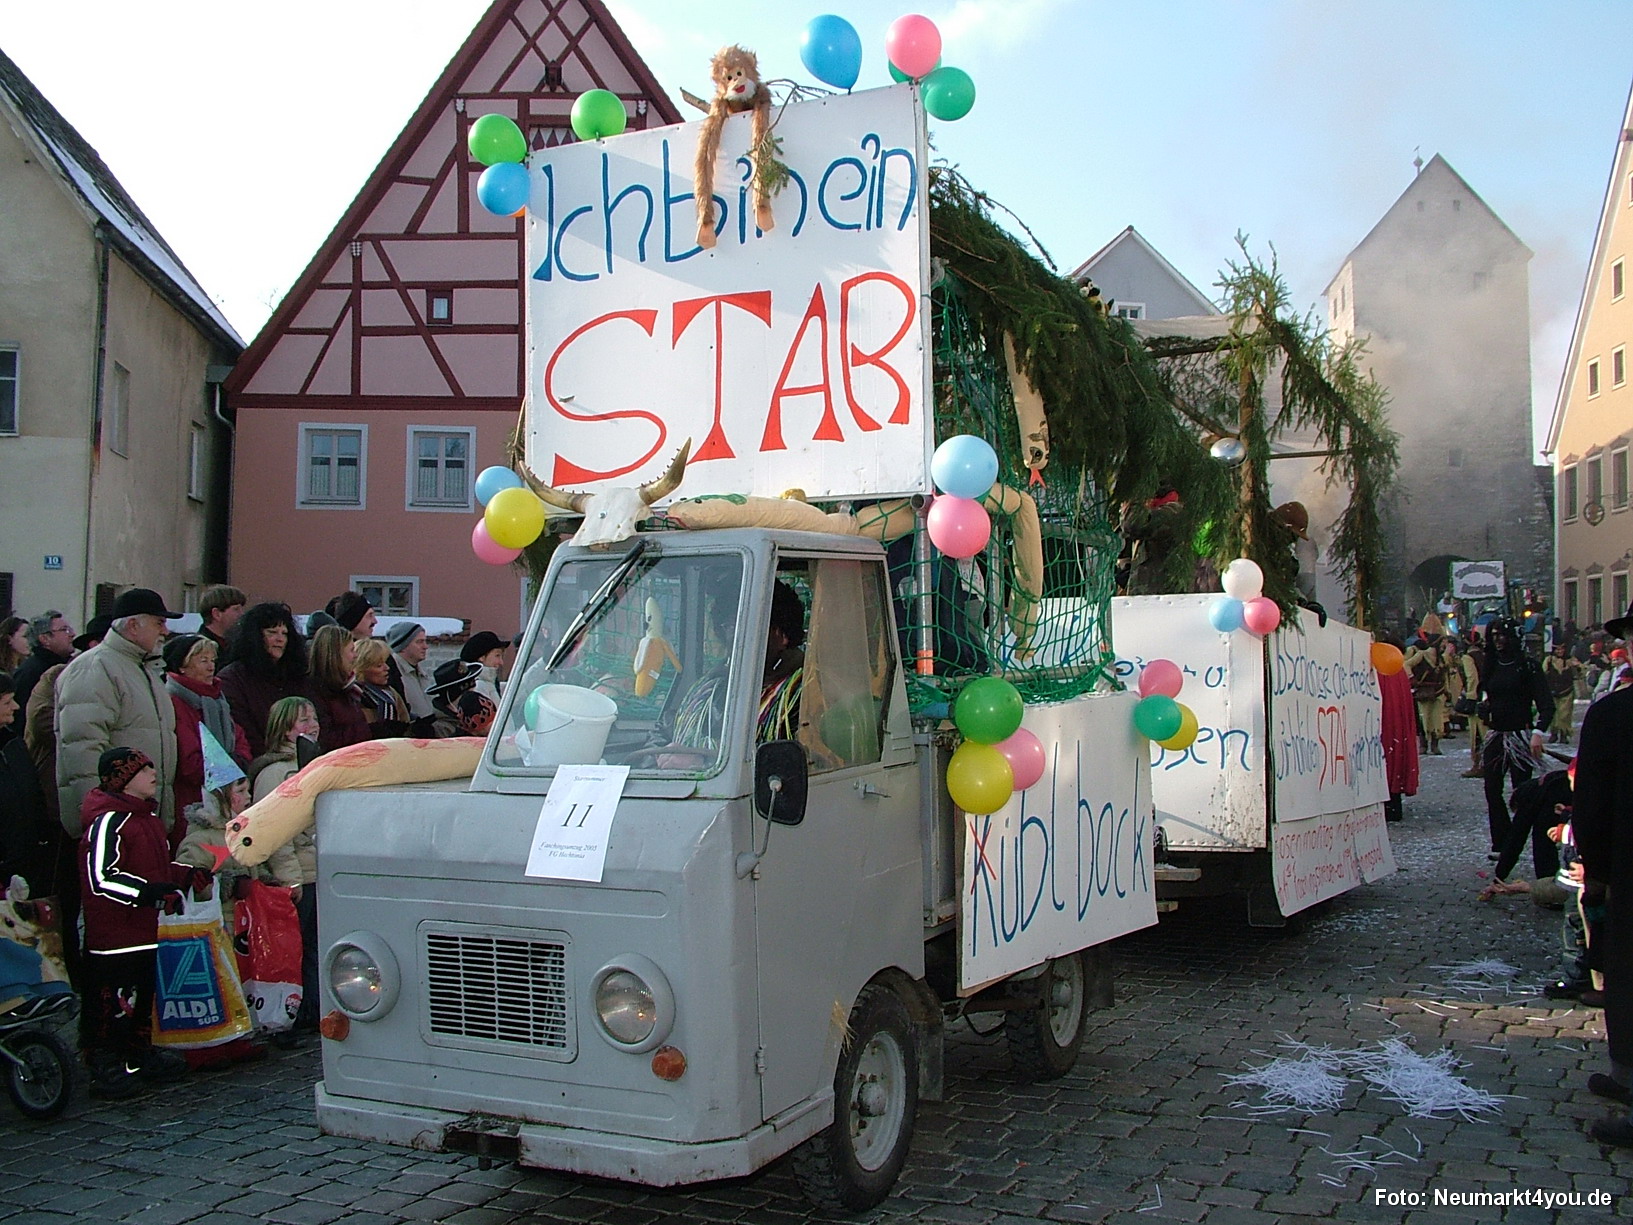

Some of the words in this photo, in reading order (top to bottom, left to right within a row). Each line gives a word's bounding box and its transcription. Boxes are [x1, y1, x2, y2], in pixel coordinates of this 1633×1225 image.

[532, 153, 655, 282] Ich
[817, 132, 918, 231] ein
[544, 271, 917, 488] STAR
[48, 556, 59, 565] 10
[561, 803, 594, 828] 11
[163, 998, 218, 1020] ALDI
[198, 1014, 220, 1026] SÜD
